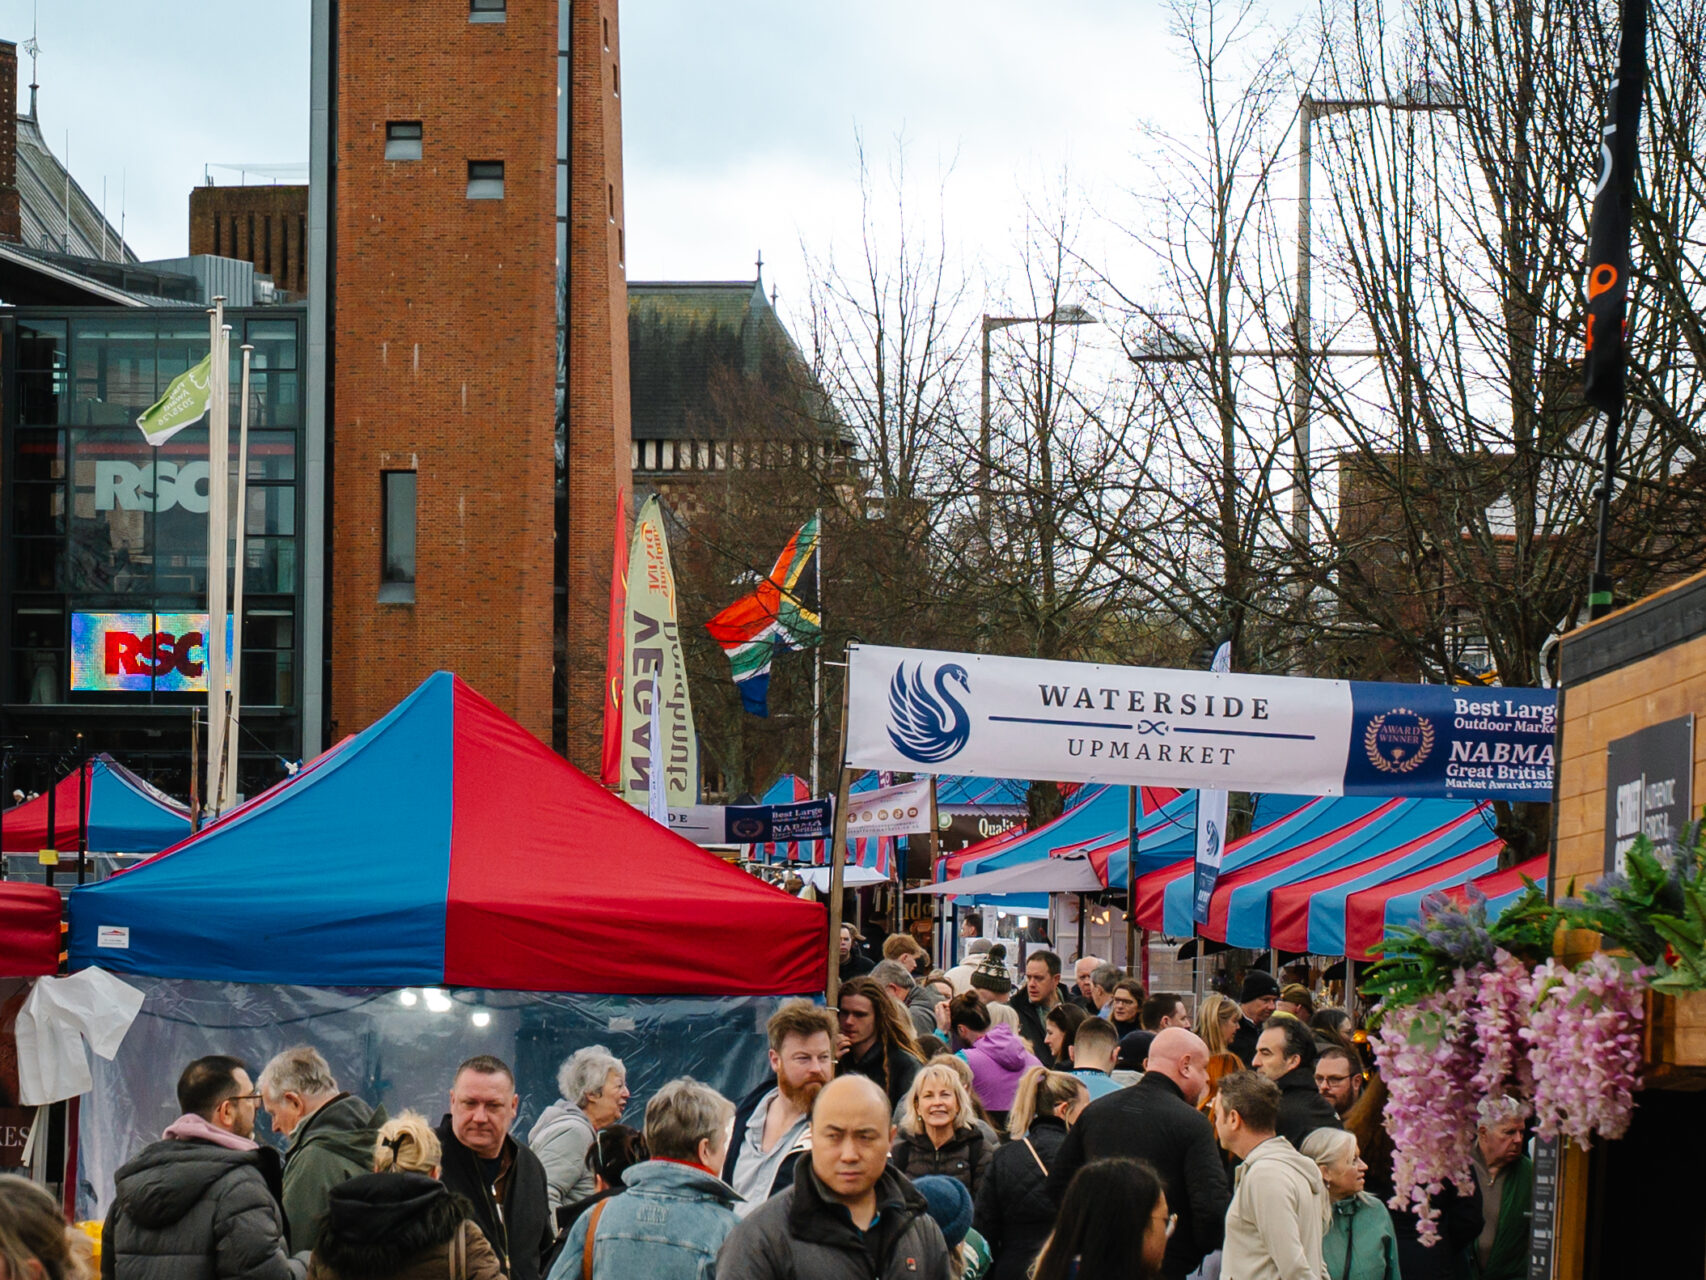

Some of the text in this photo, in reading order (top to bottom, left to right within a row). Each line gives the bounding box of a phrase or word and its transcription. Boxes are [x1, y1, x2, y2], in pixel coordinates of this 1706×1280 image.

[104, 631, 203, 678] RSC
[1038, 684, 1269, 720] WATERSIDE
[1454, 698, 1558, 724] Best Larg
[1381, 724, 1421, 736] AWARD
[1454, 717, 1557, 734] Outdoor Marke
[1379, 734, 1420, 745] WINNER
[1067, 738, 1236, 765] UPMARKET
[1449, 741, 1555, 765] NABMA
[1446, 764, 1494, 778] Great
[1445, 777, 1554, 790] Market Awards 202
[978, 817, 1017, 838] Qualit
[0, 1126, 31, 1147] ES
